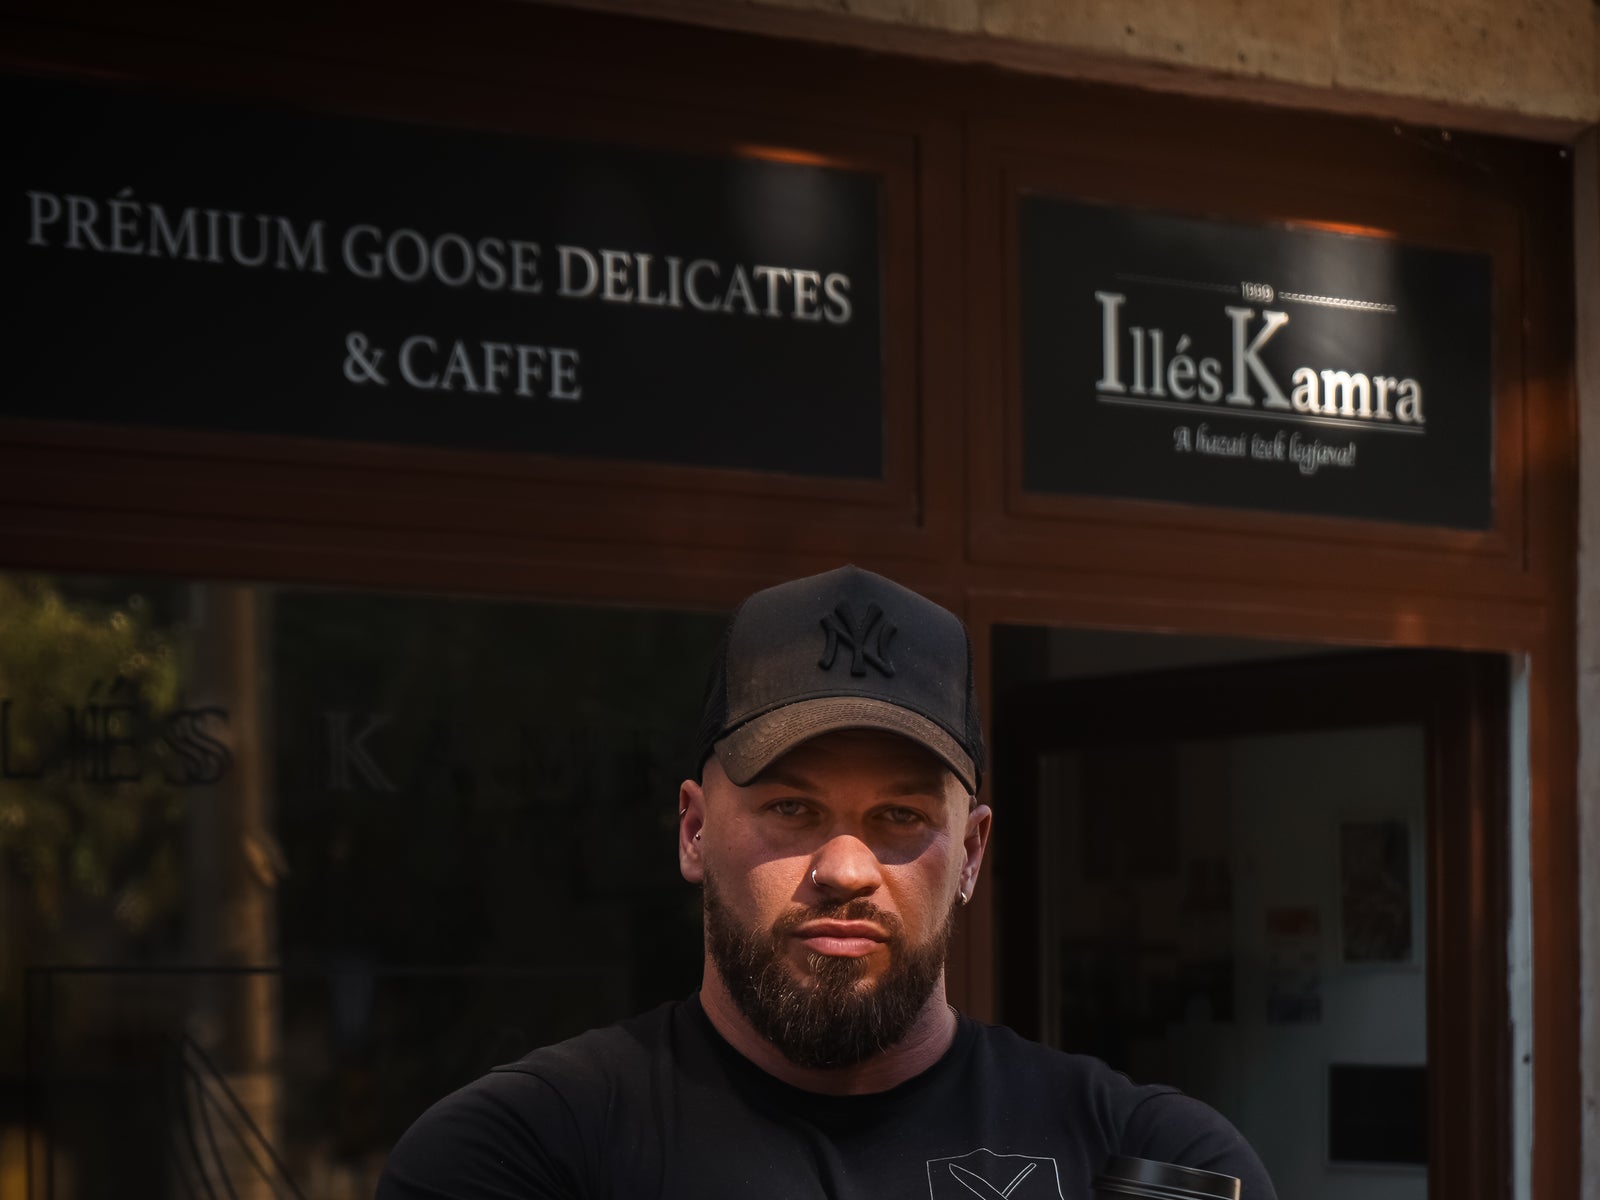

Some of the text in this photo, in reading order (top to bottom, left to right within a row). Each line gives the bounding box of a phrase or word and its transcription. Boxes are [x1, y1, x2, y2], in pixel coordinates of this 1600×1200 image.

[25, 186, 854, 325] PRÉMIUM GOOSE DELICATES
[342, 331, 583, 402] & CAFFE
